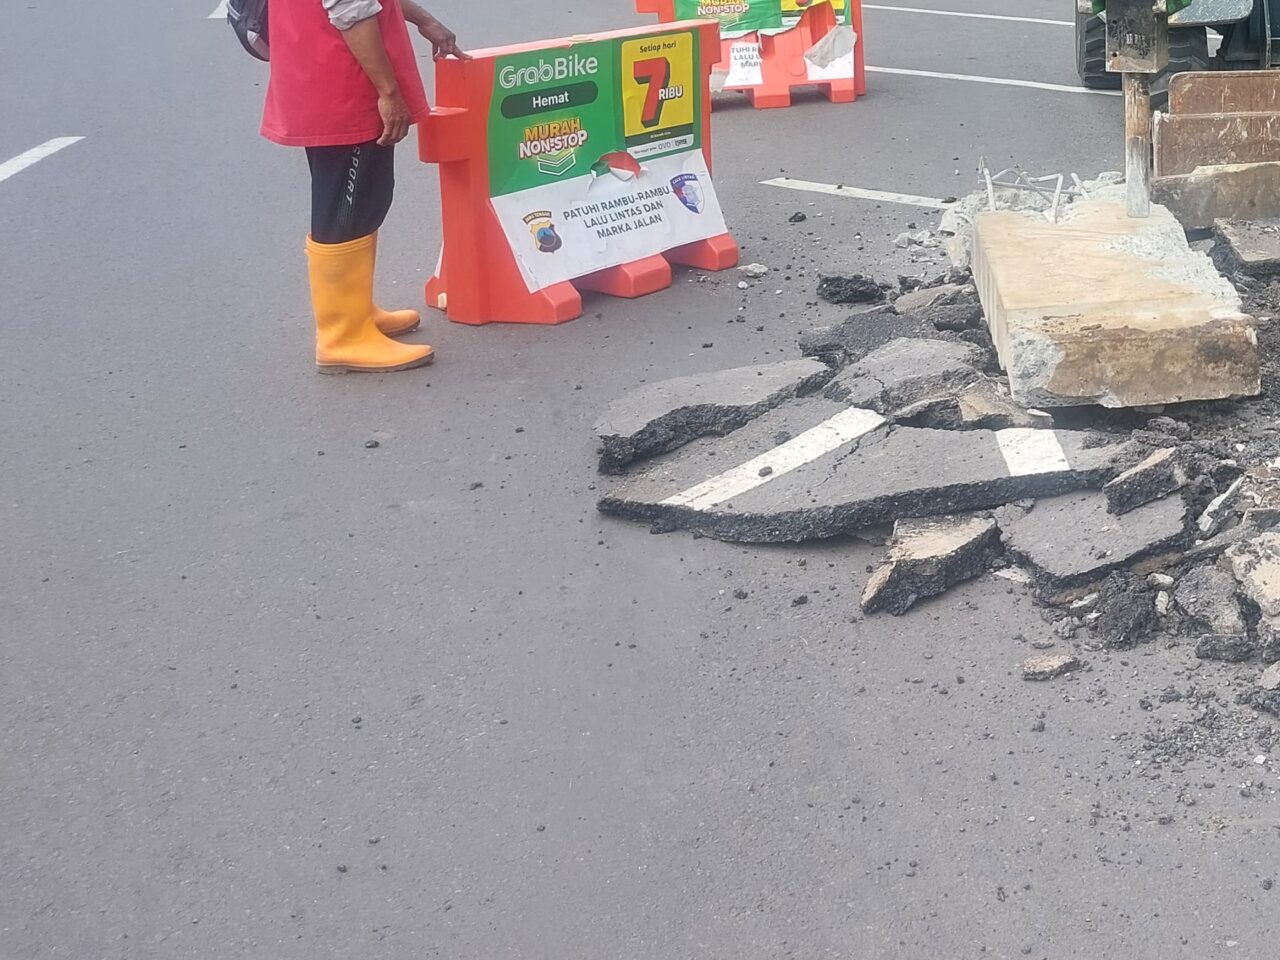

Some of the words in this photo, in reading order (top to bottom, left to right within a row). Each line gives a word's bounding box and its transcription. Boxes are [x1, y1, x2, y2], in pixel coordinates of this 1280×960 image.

[639, 42, 661, 54] Setiap
[662, 40, 677, 50] hari
[499, 53, 598, 89] GrabBike
[532, 91, 570, 109] Hemat
[633, 56, 671, 129] 7
[658, 85, 684, 101] RIBU
[524, 118, 582, 141] MURAH
[346, 144, 361, 205] SPORT
[562, 202, 601, 221] PATUHI
[600, 185, 671, 211] RAMBU-RAMBU
[583, 215, 609, 230] LALU
[610, 205, 644, 223] LINTAS
[643, 199, 665, 212] DAN
[596, 221, 632, 239] MARKA
[632, 213, 663, 230] JALAN
